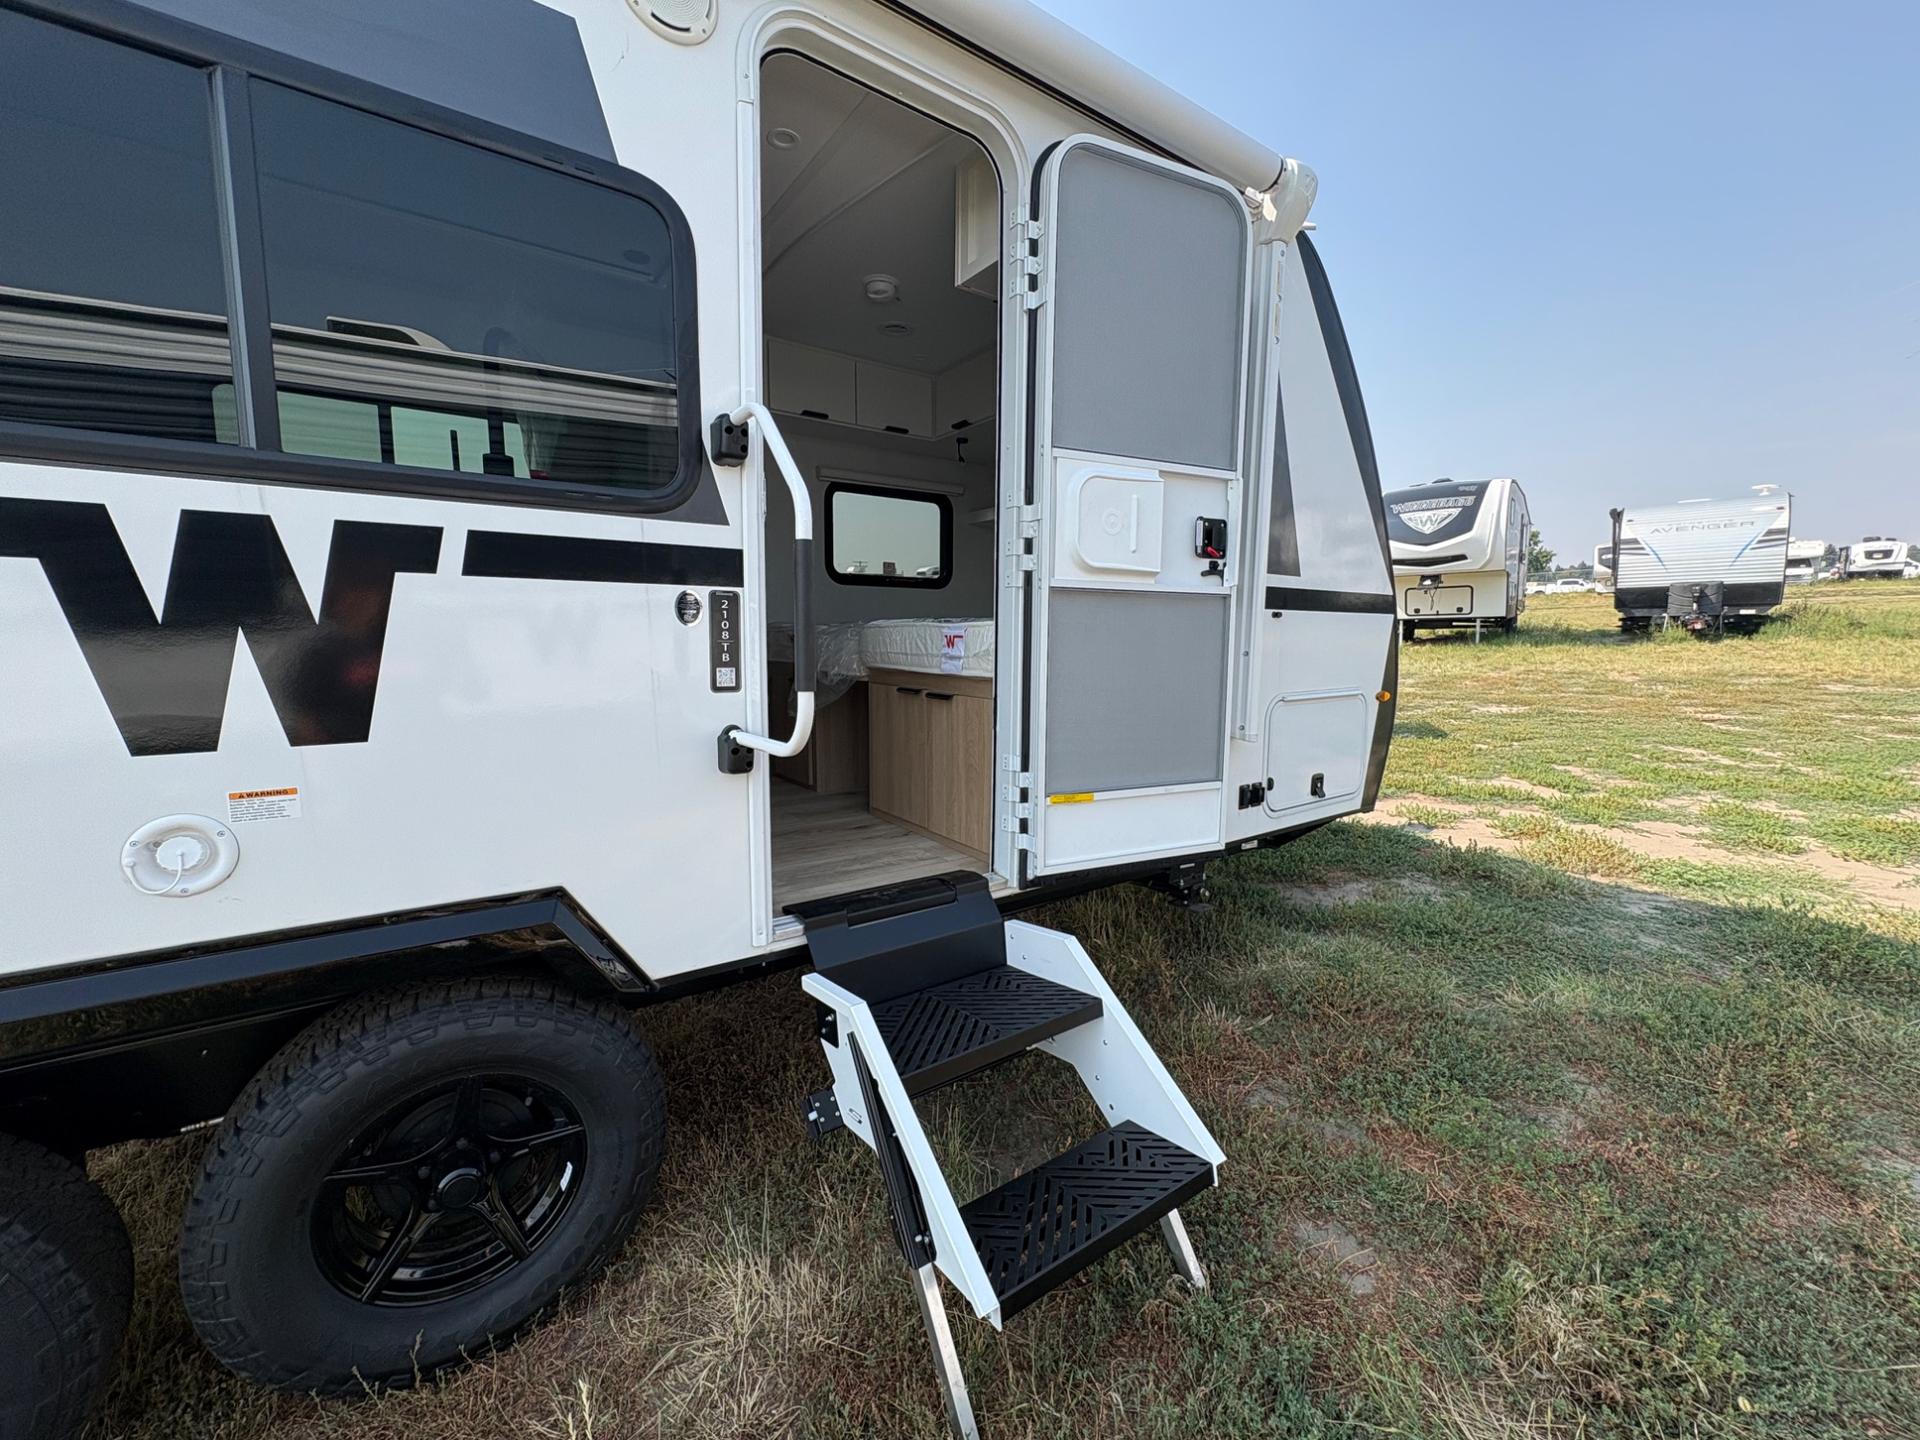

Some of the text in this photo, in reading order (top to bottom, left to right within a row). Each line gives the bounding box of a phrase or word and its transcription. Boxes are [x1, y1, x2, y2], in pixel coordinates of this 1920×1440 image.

[1650, 521, 1755, 534] AVENGER
[0, 497, 444, 757] W
[245, 789, 289, 799] WARNING
